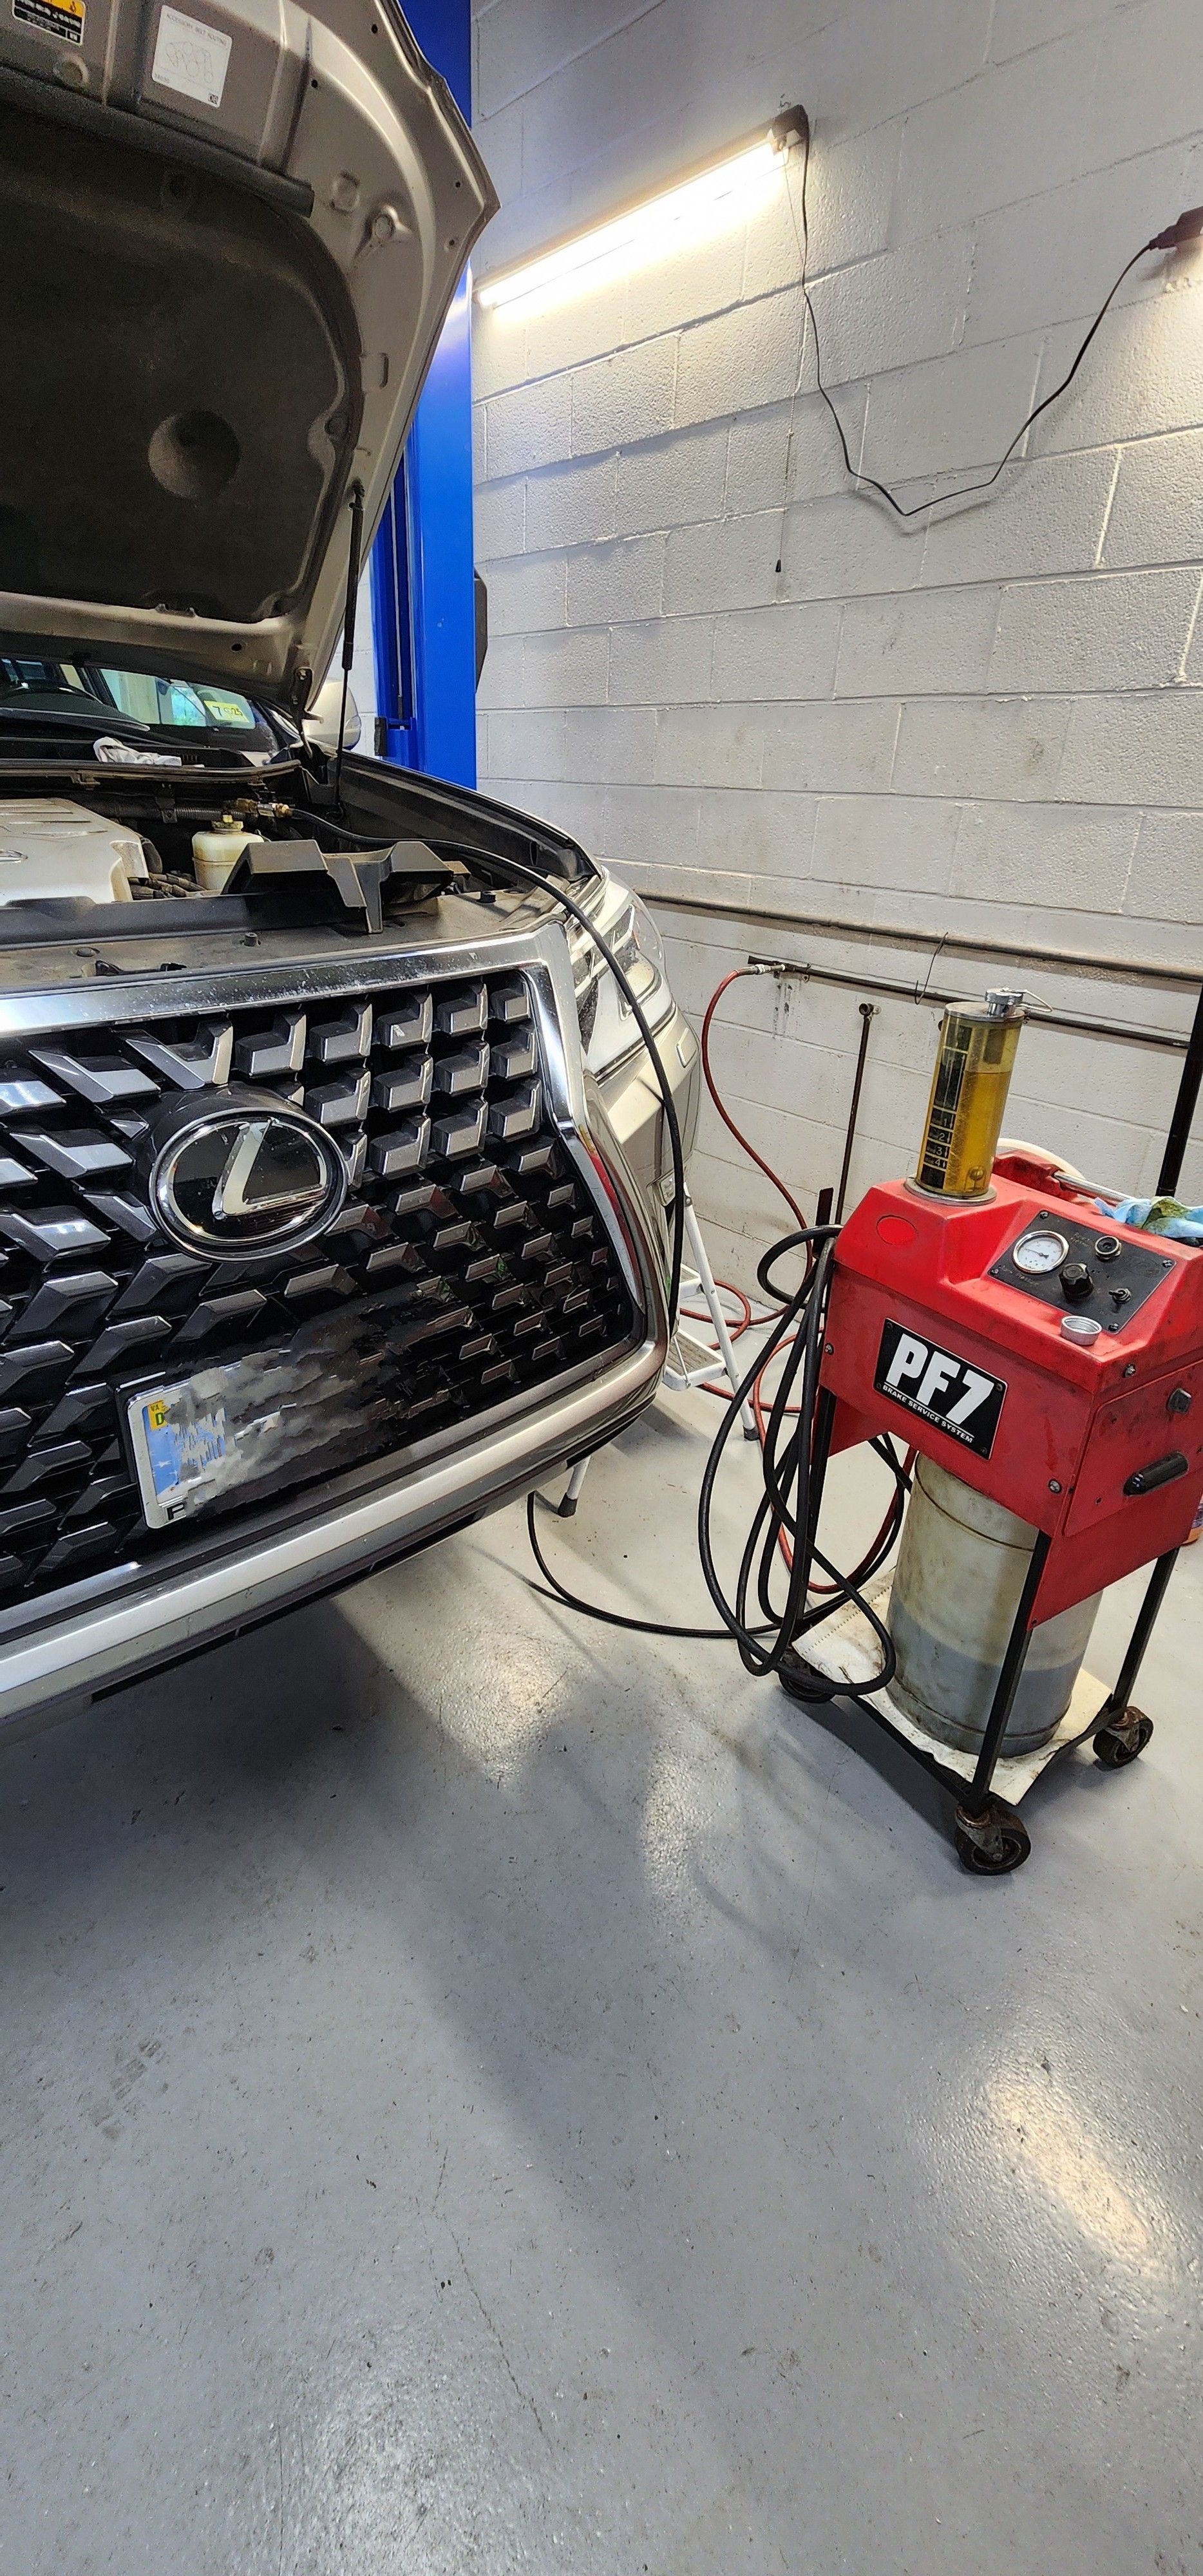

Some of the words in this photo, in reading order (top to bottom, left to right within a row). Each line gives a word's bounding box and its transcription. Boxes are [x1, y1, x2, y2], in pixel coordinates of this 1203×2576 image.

[213, 706, 222, 716] 7
[939, 1133, 945, 1141] 2
[936, 1147, 942, 1155] 3
[886, 1332, 995, 1425] PF7
[883, 1385, 907, 1403] BRAKE
[908, 1400, 940, 1423] SERVICE
[942, 1421, 973, 1443] SYSTEM
